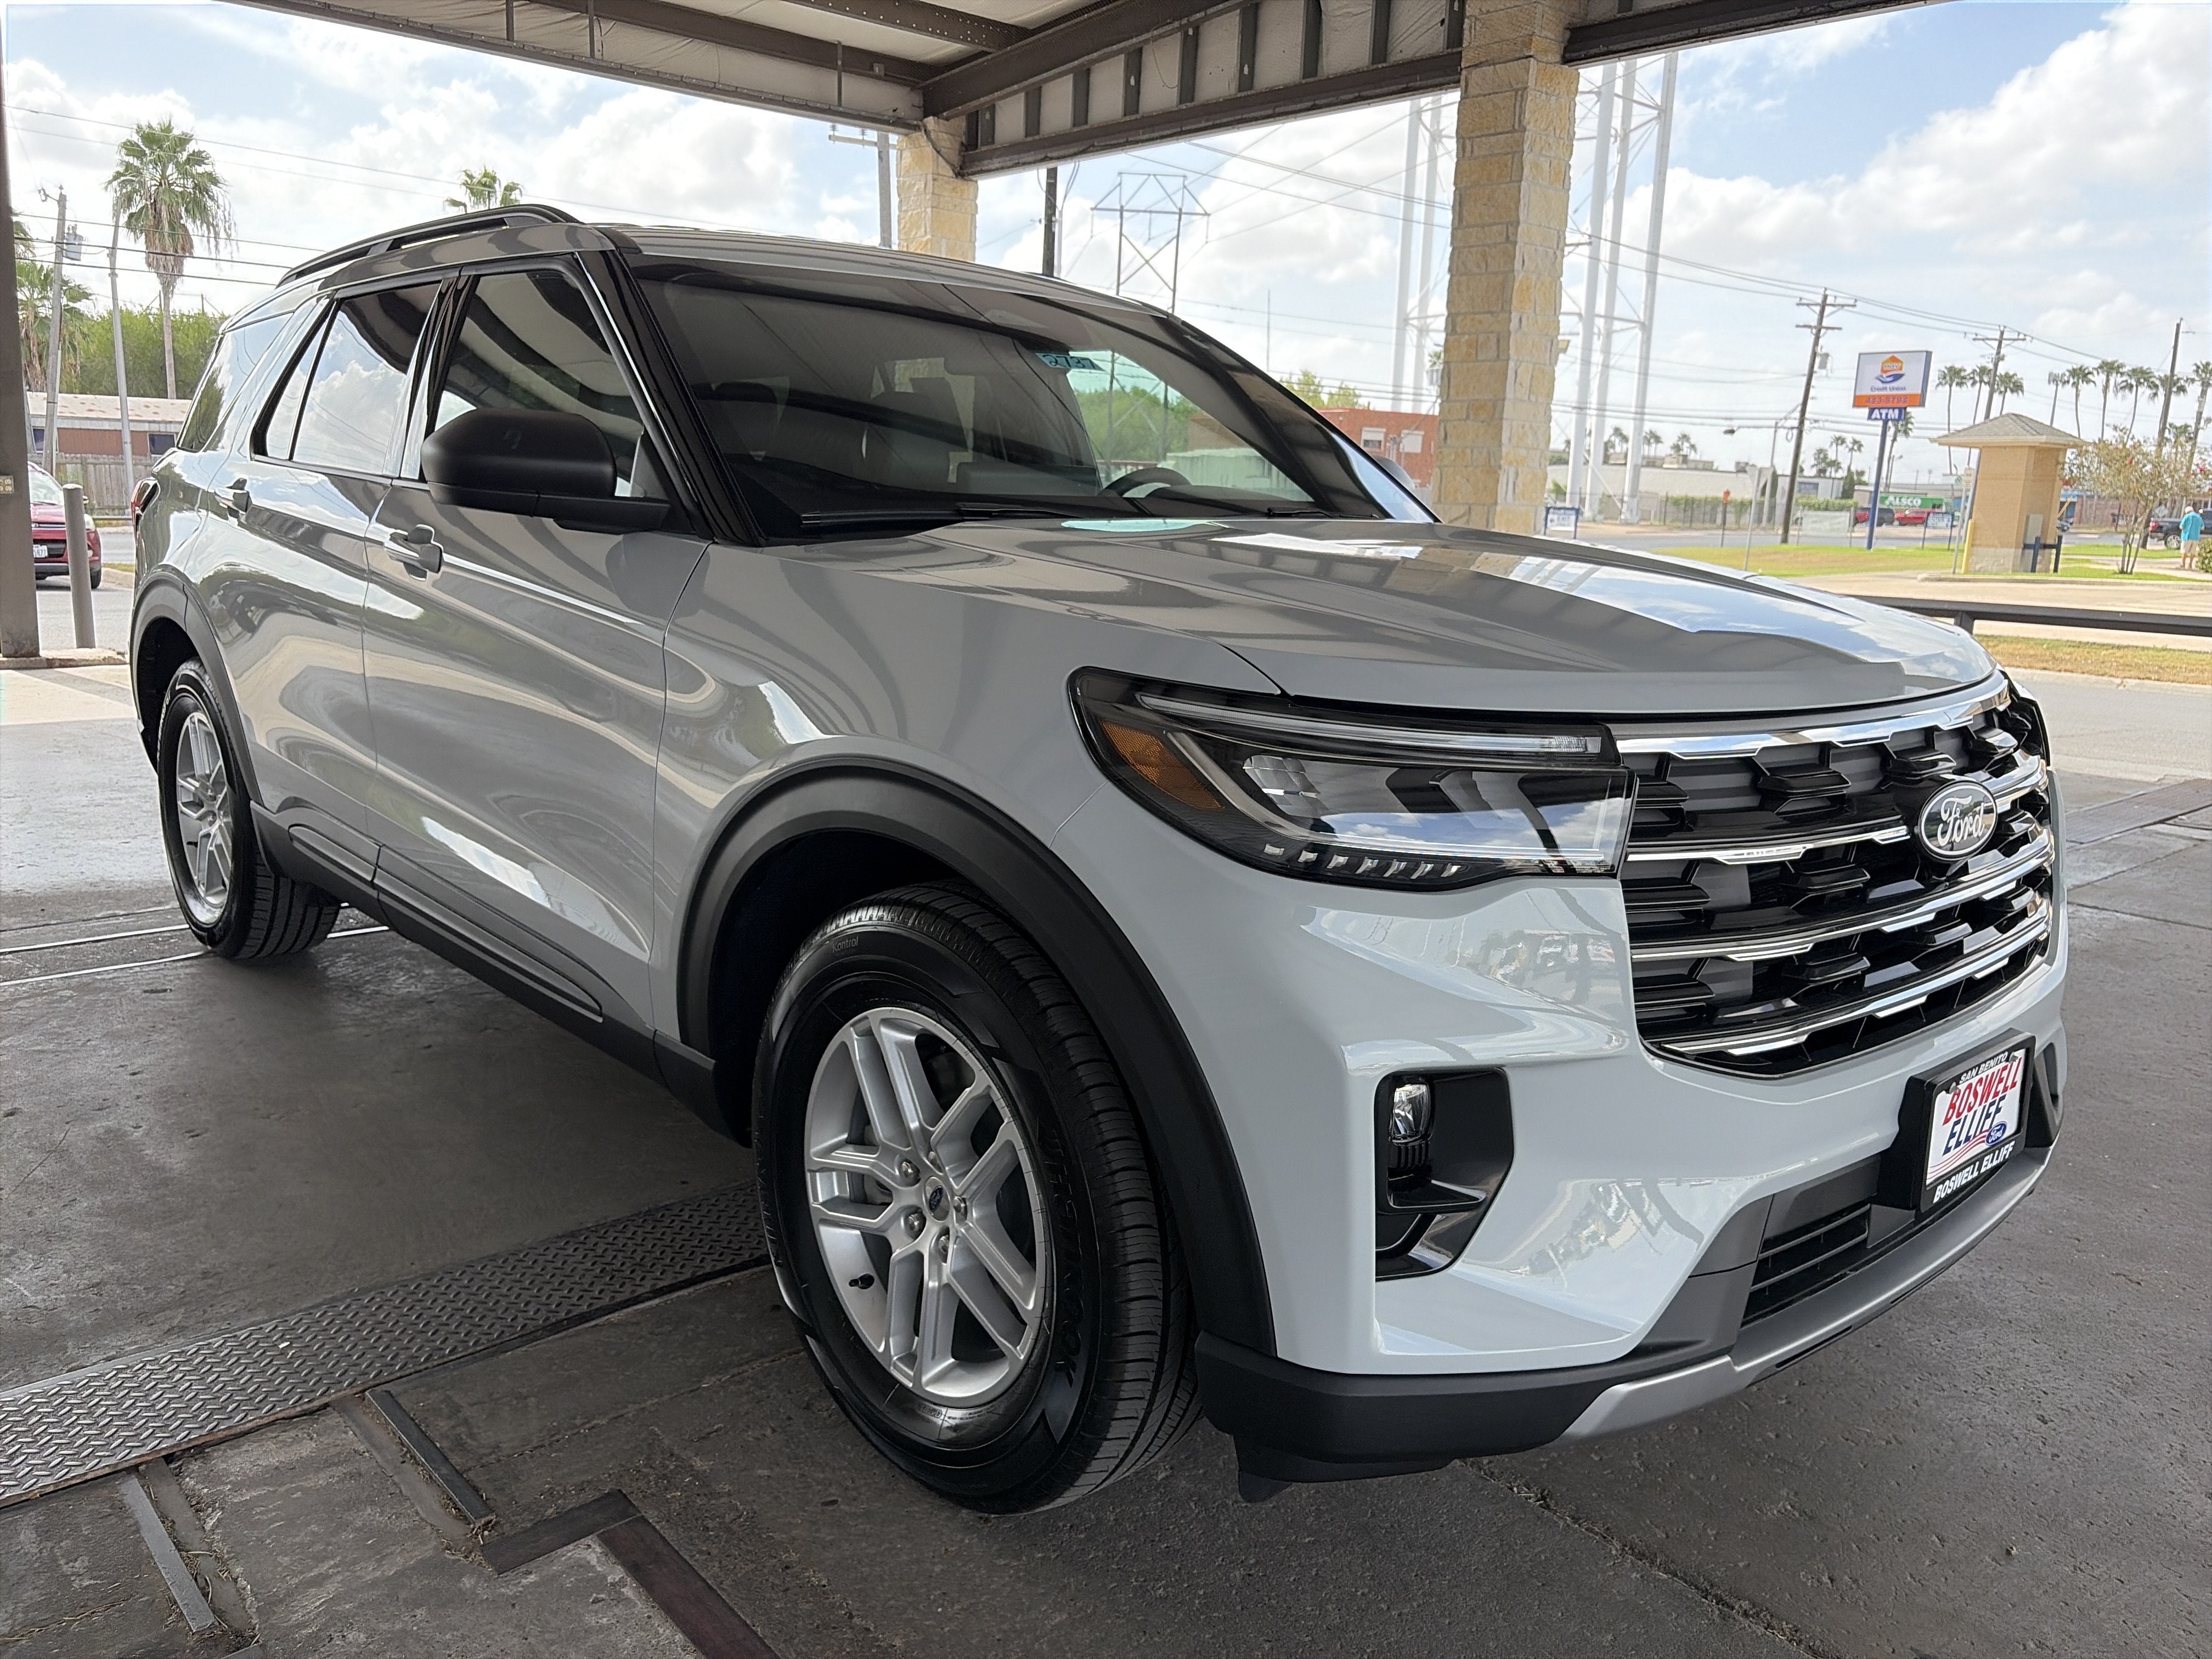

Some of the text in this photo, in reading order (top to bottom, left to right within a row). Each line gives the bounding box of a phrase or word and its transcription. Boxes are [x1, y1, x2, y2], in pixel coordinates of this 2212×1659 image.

[1871, 408, 1899, 419] ATM
[1937, 795, 1985, 847] Ford
[832, 936, 859, 953] Kontrol
[1959, 1051, 2008, 1085] SAN BENITO
[1942, 1057, 2022, 1126] BOSWELL
[1942, 1094, 2007, 1157] ELLIFF
[1988, 1125, 2004, 1143] Ford
[1933, 1141, 2016, 1204] BOSWELL ELLIFF
